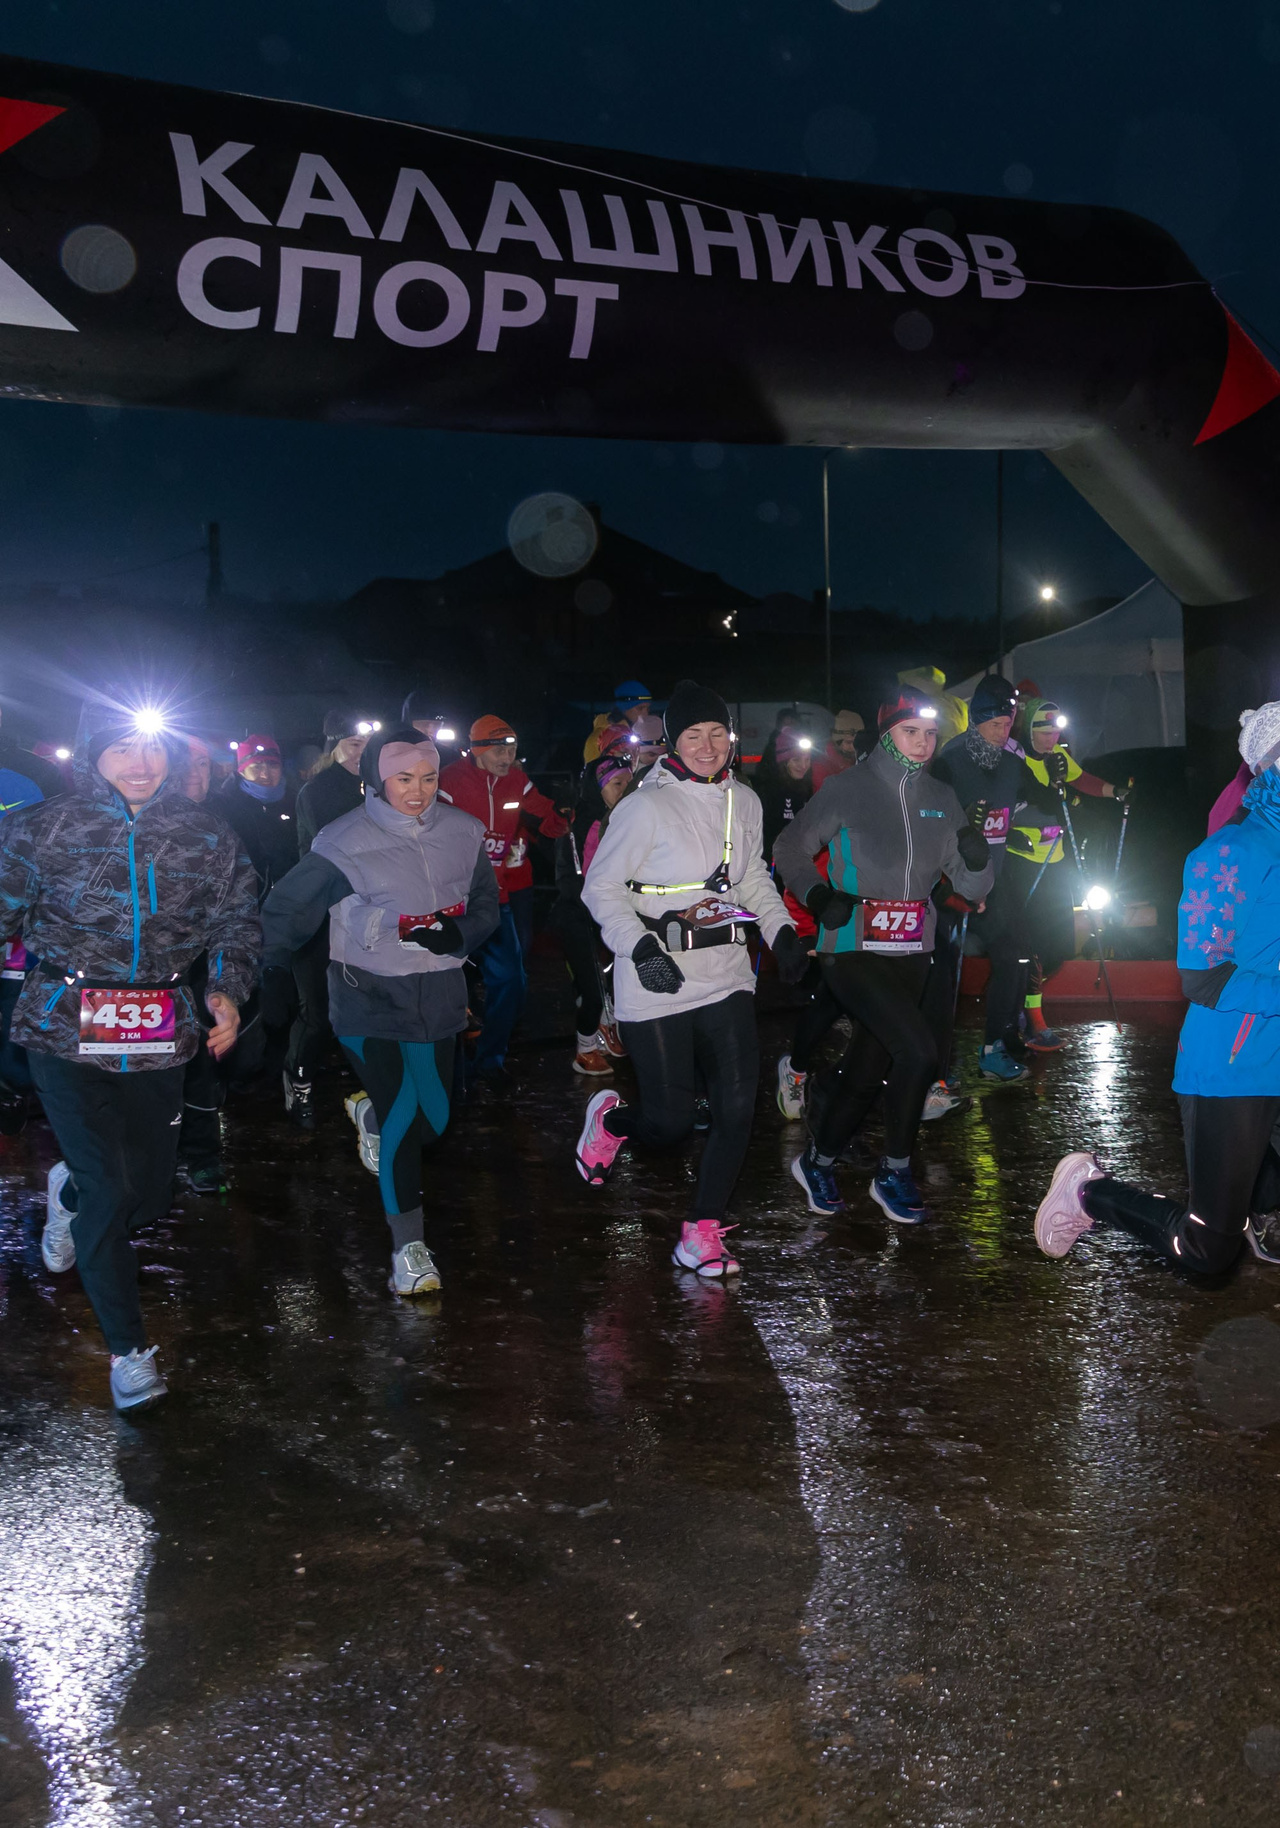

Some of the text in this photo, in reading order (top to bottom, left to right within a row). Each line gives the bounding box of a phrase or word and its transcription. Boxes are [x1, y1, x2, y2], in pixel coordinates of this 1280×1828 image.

[168, 131, 1027, 299] КАЛАШНИКОВ
[177, 236, 619, 359] СПОРТ
[984, 816, 1004, 831] 04
[482, 837, 506, 854] 05
[871, 910, 918, 932] 475
[92, 1003, 163, 1029] 433
